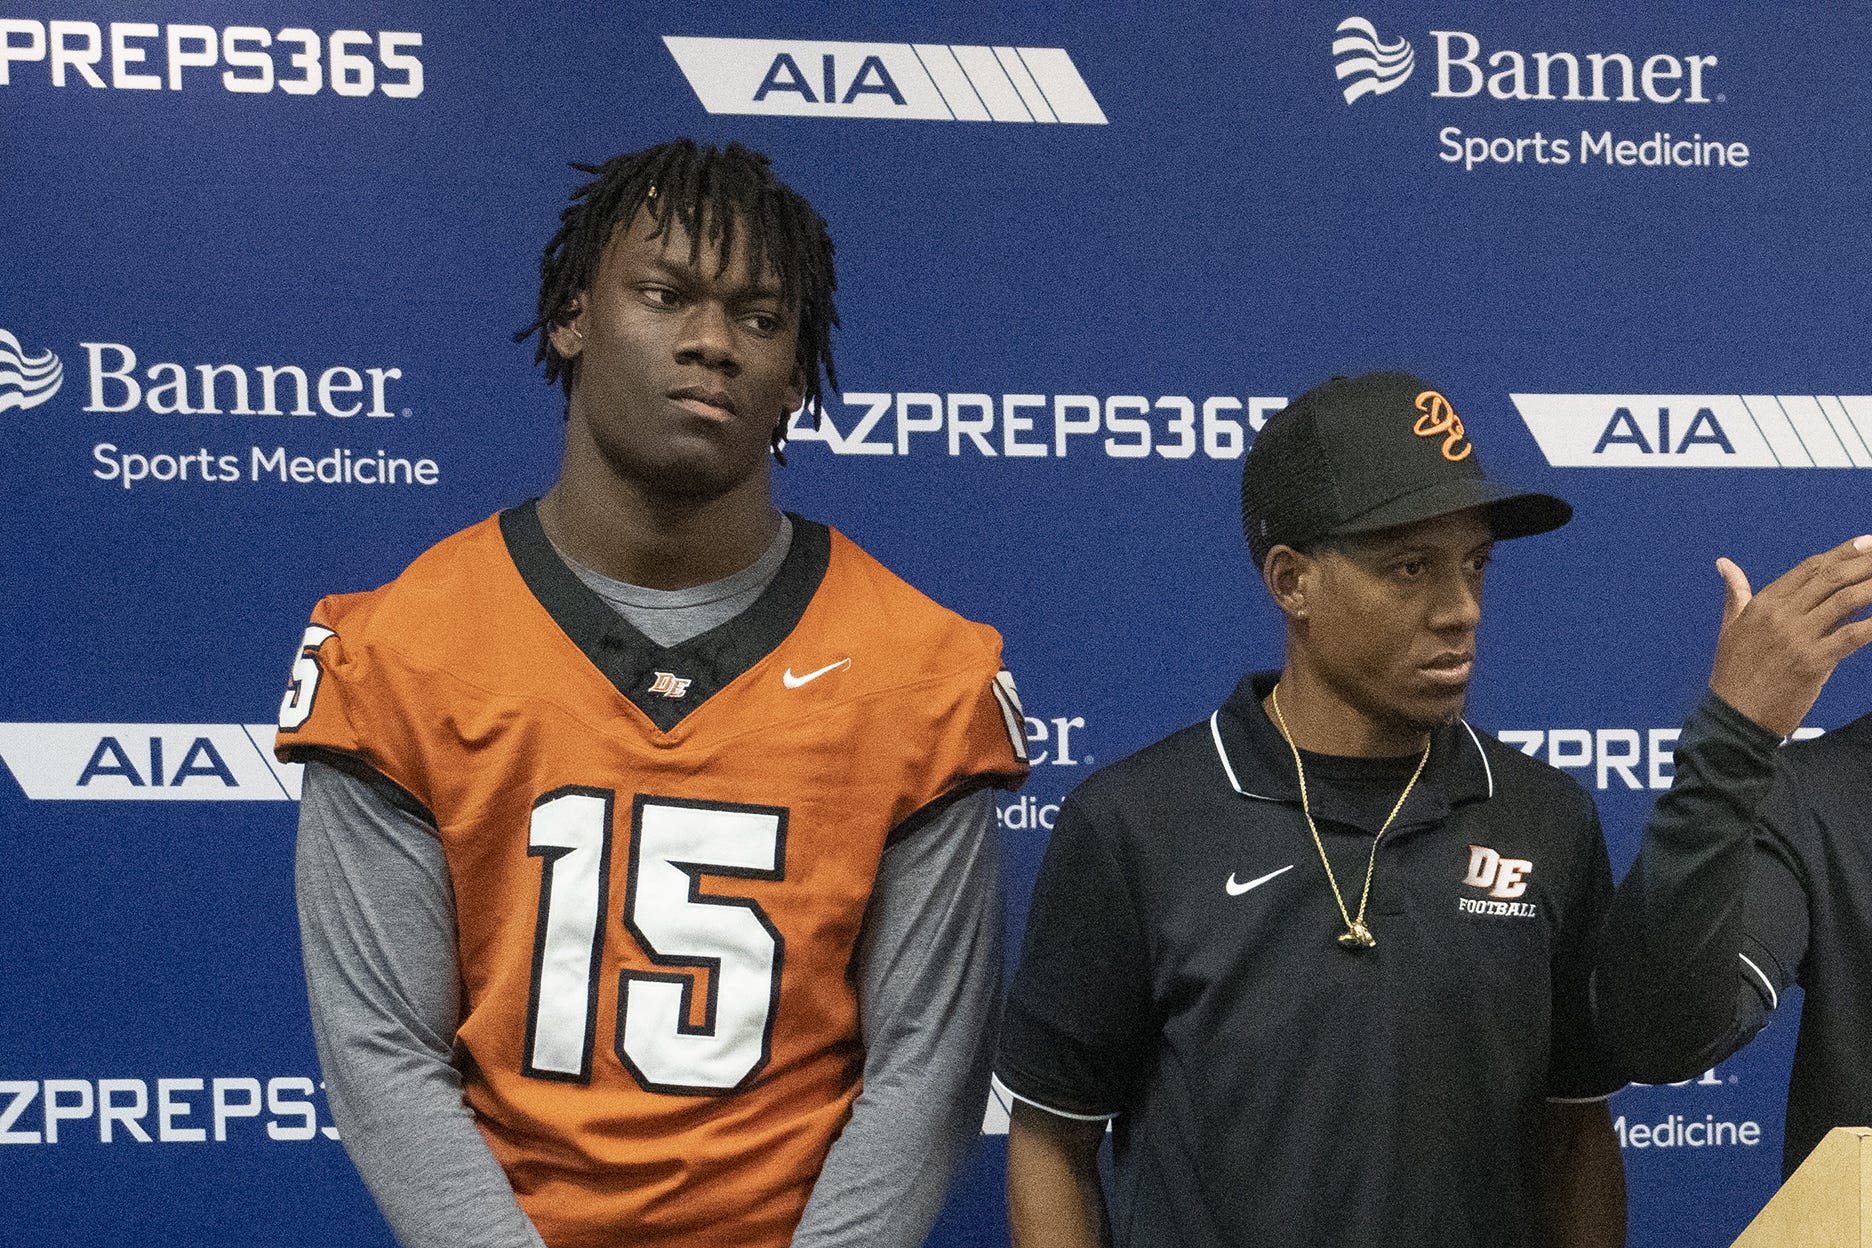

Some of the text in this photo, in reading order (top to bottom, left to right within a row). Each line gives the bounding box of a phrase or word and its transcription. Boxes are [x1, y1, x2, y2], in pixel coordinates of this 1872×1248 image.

[0, 18, 425, 98] PREPS365
[753, 53, 907, 105] AIA
[1429, 30, 1718, 104] Banner
[1438, 127, 1750, 170] Sports Medicine
[80, 341, 403, 419] Banner
[1592, 406, 1736, 455] AIA
[93, 442, 440, 489] Sports Medicine
[76, 737, 240, 788] AIA
[1461, 843, 1533, 898] DE
[1458, 897, 1537, 918] FOOTBALL
[522, 783, 790, 1098] 15
